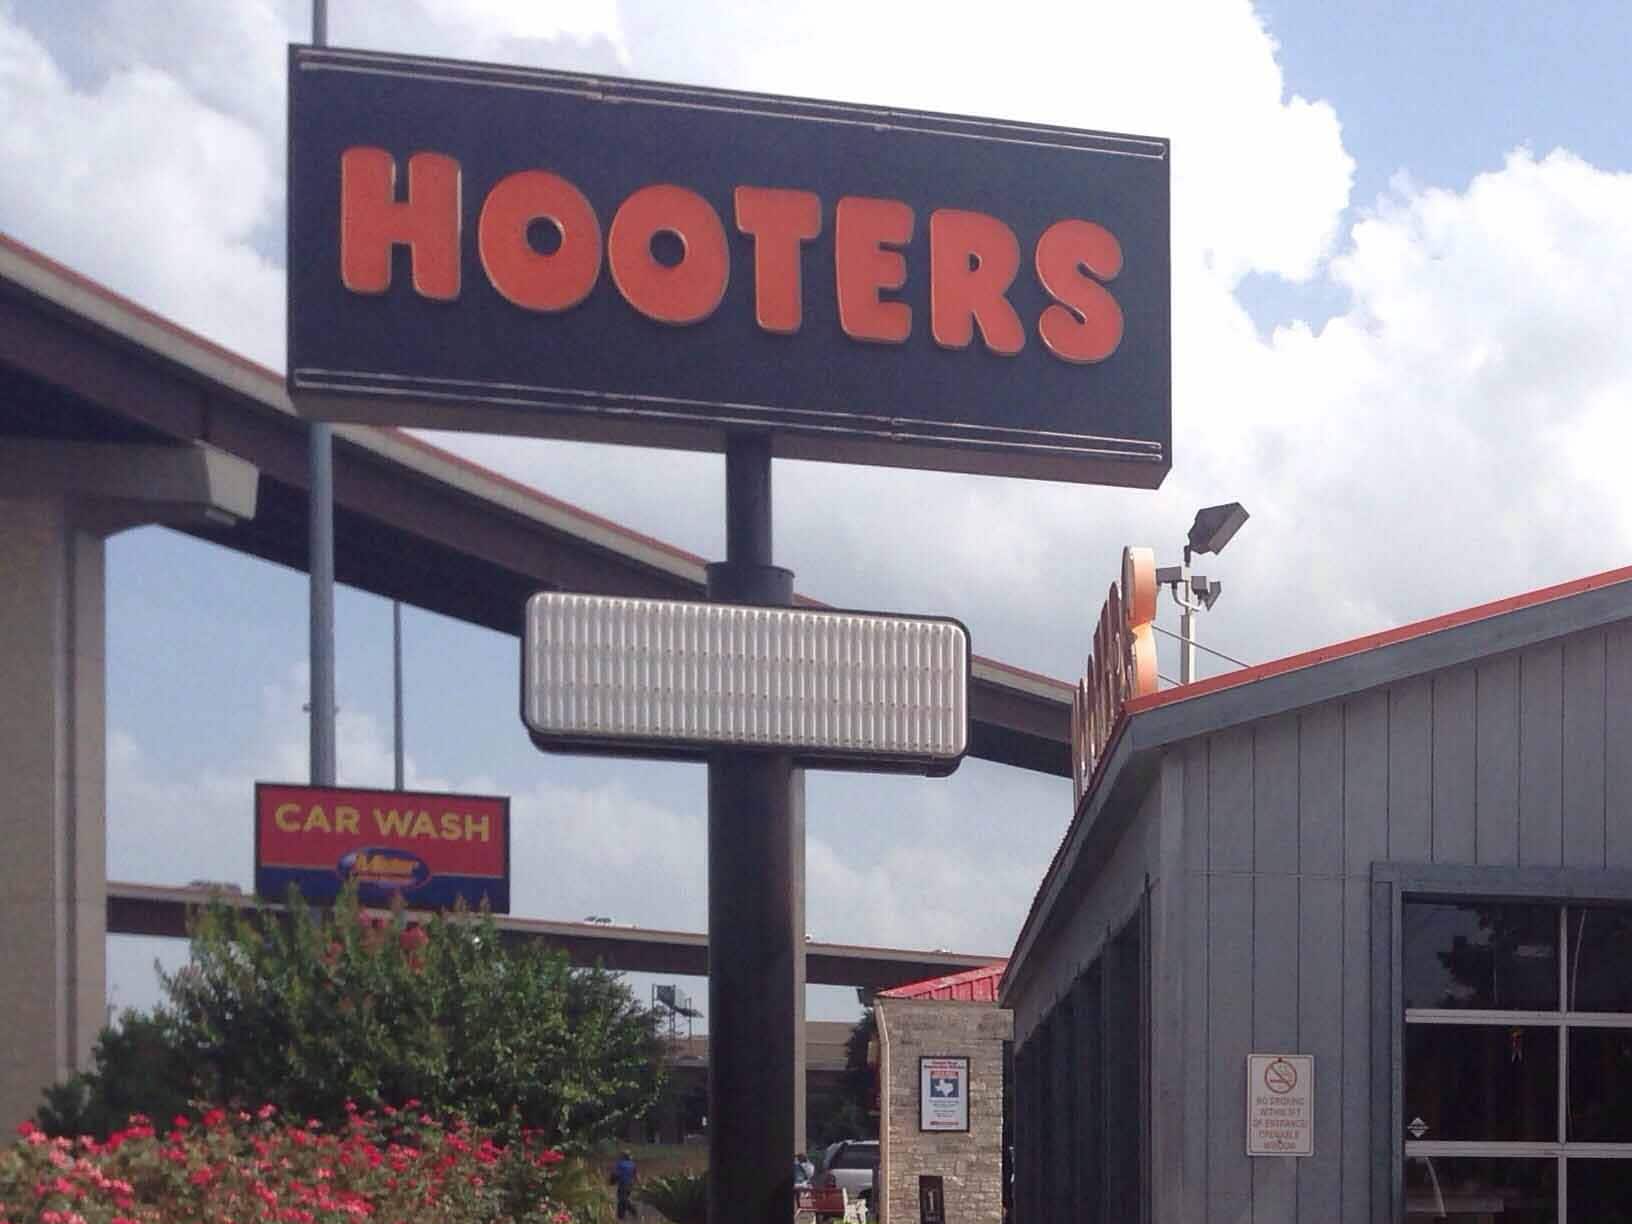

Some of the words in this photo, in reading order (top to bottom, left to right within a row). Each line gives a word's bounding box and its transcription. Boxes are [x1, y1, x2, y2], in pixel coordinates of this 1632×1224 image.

[340, 146, 1125, 364] HOOTERS
[274, 803, 361, 835] CAR
[372, 808, 490, 842] WASH
